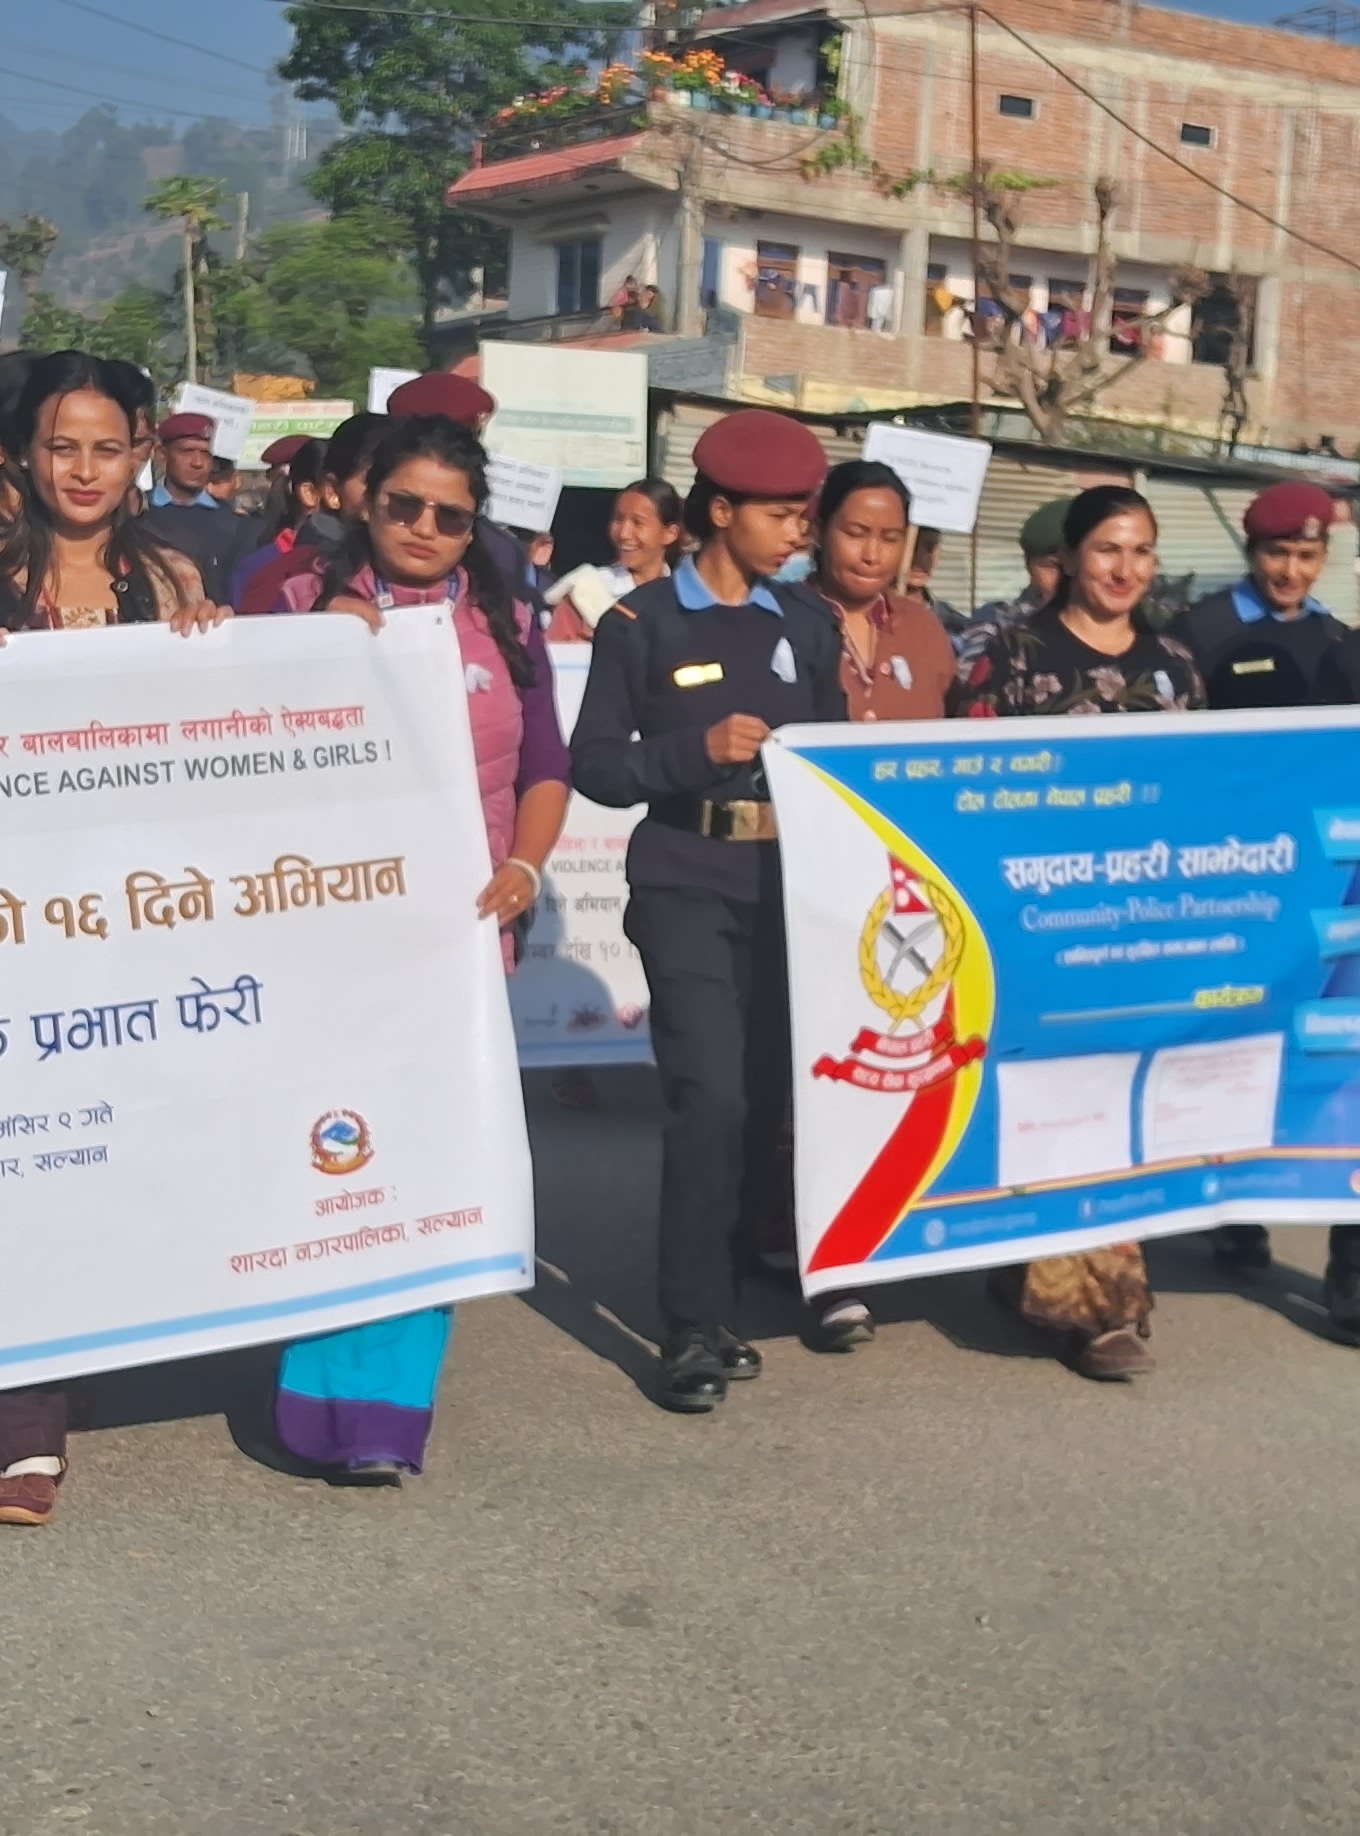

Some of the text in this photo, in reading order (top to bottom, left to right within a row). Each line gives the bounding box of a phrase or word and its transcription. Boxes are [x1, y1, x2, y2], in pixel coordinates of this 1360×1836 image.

[21, 720, 169, 756] बालबालिकामा
[180, 708, 274, 741] लगानीको
[58, 761, 174, 794] AGAINST
[184, 748, 286, 782] WOMEN
[292, 747, 307, 771] &
[313, 740, 378, 768] GIRLS
[385, 740, 392, 762] !
[551, 860, 612, 873] VIOLENCE
[1004, 833, 1296, 894] समुदाय-प्रहरी साझेदारी
[43, 894, 110, 941] १६
[125, 866, 215, 930] दिने
[230, 854, 407, 918] अभियान
[1022, 891, 1280, 930] Community-Police Partnership
[30, 999, 159, 1062] प्रभात
[176, 974, 264, 1034] फेरी
[78, 1100, 114, 1126] गते
[33, 1145, 108, 1172] सल्यान
[315, 1186, 386, 1218] आयोजक
[229, 1206, 484, 1274] शारदा नगरपालिका, सल्यान
